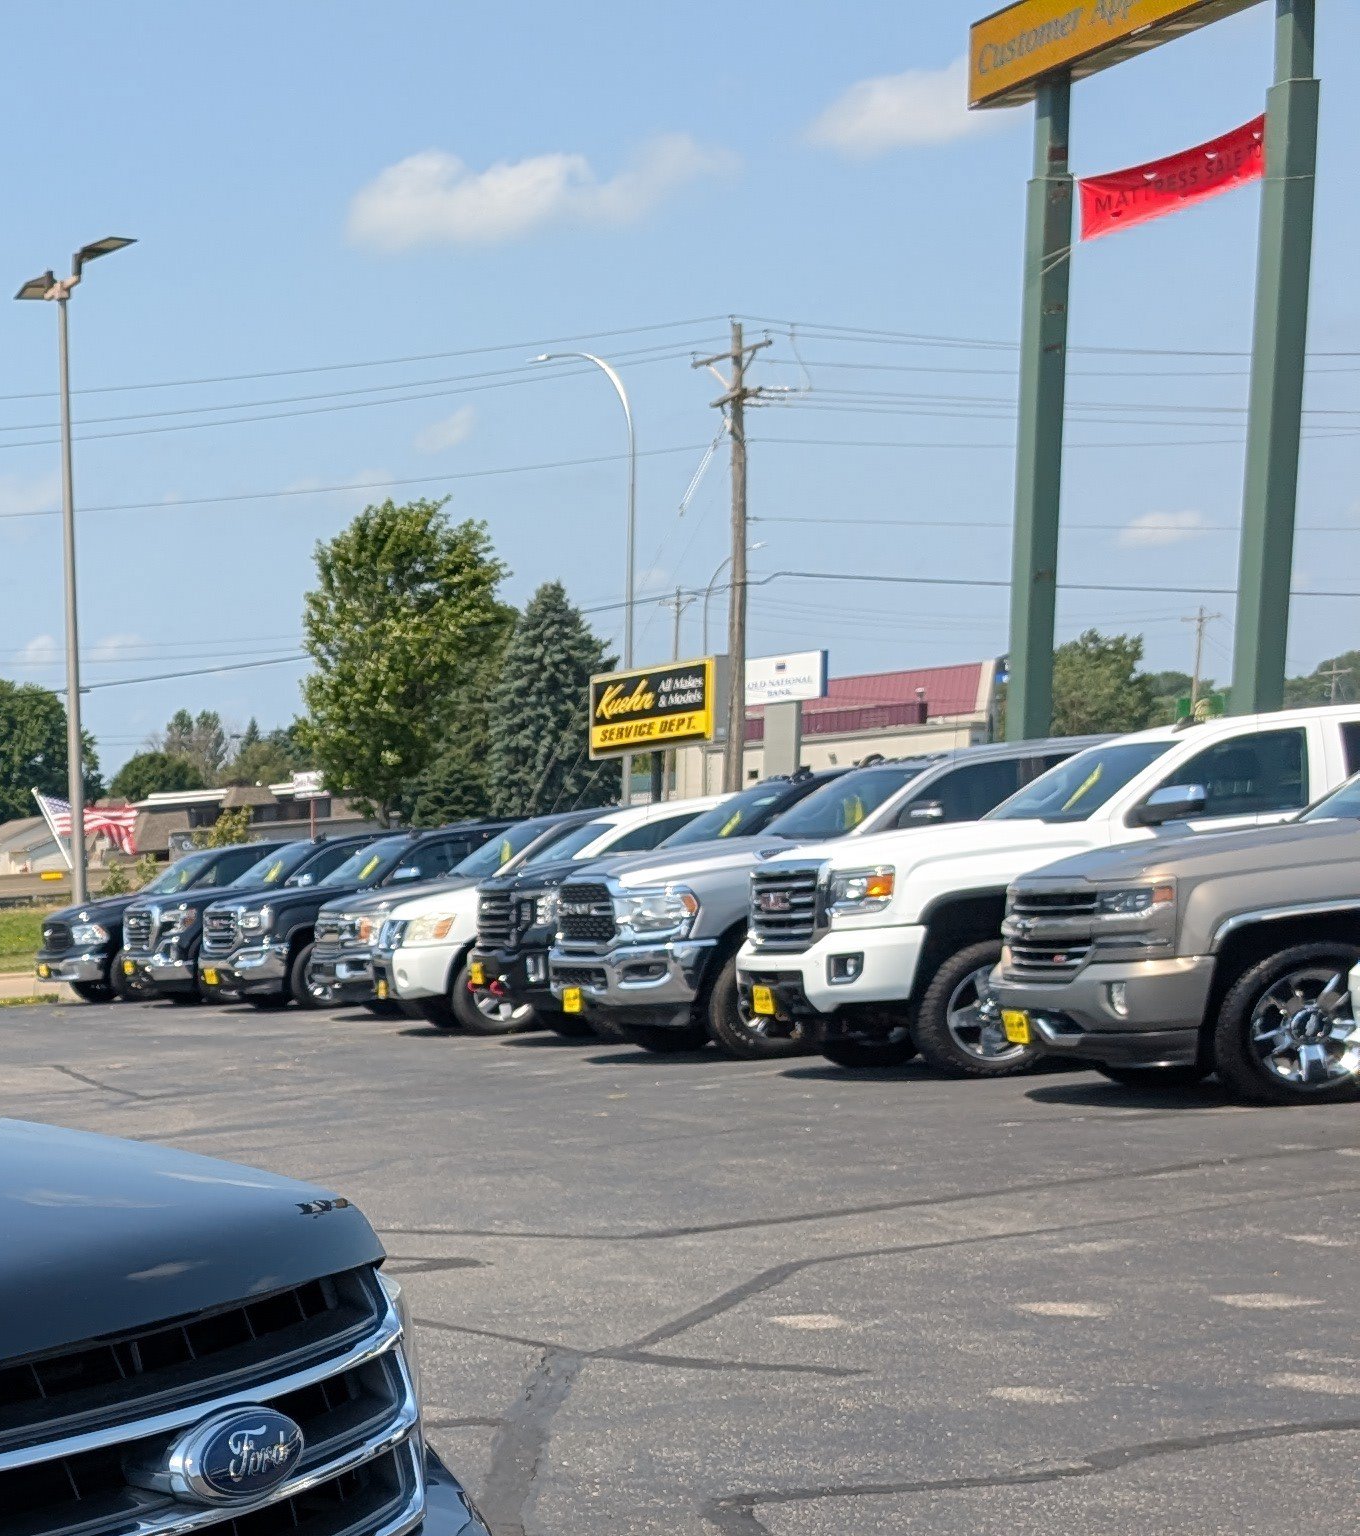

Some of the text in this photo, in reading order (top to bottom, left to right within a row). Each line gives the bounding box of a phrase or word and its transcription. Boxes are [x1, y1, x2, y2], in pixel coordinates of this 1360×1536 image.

[979, 8, 1081, 76] Customer
[1094, 166, 1198, 213] MATTRESS
[1204, 150, 1243, 176] SALE
[596, 677, 656, 720] Kuehn
[658, 694, 668, 708] &
[768, 675, 813, 688] NATIONAL
[600, 713, 697, 743] SERVICE DEPT.
[228, 1424, 290, 1483] Ford
